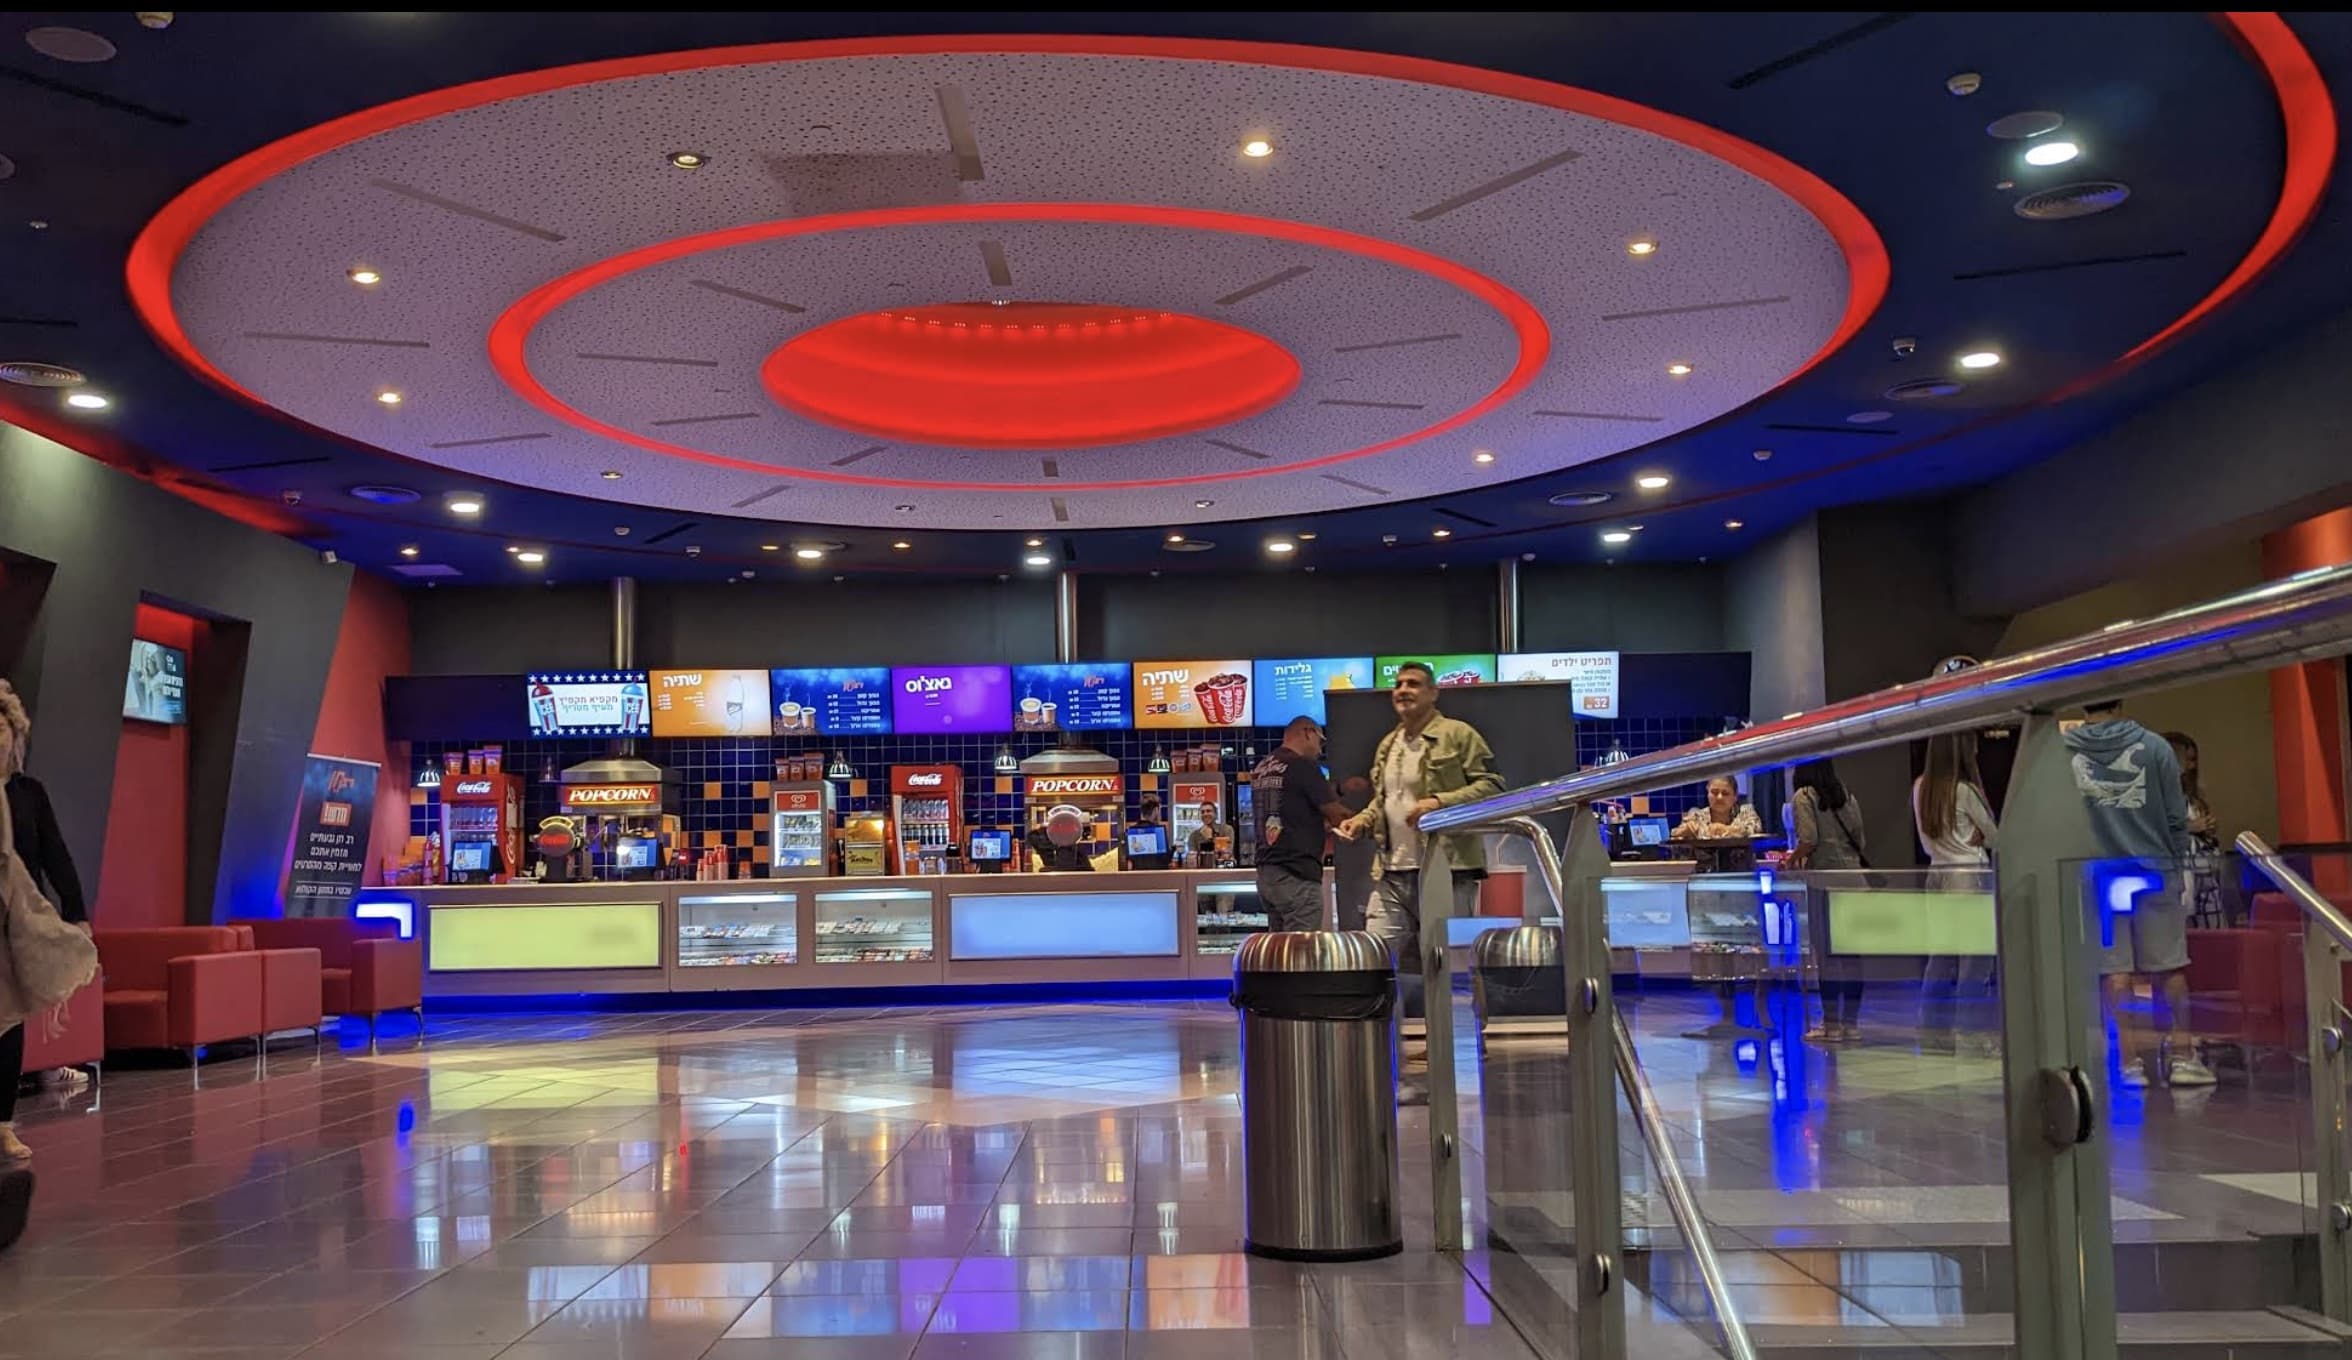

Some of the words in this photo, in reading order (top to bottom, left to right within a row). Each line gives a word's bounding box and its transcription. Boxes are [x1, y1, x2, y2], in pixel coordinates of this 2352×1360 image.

[1552, 657, 1578, 667] ילדים
[1580, 656, 1612, 666] תפריט
[1274, 662, 1312, 676] גלידות
[663, 673, 702, 688] שתיה
[1142, 669, 1190, 686] שתיה
[1594, 698, 1608, 708] 32
[1032, 779, 1114, 792] POPCORN
[569, 788, 652, 802] POPCORN
